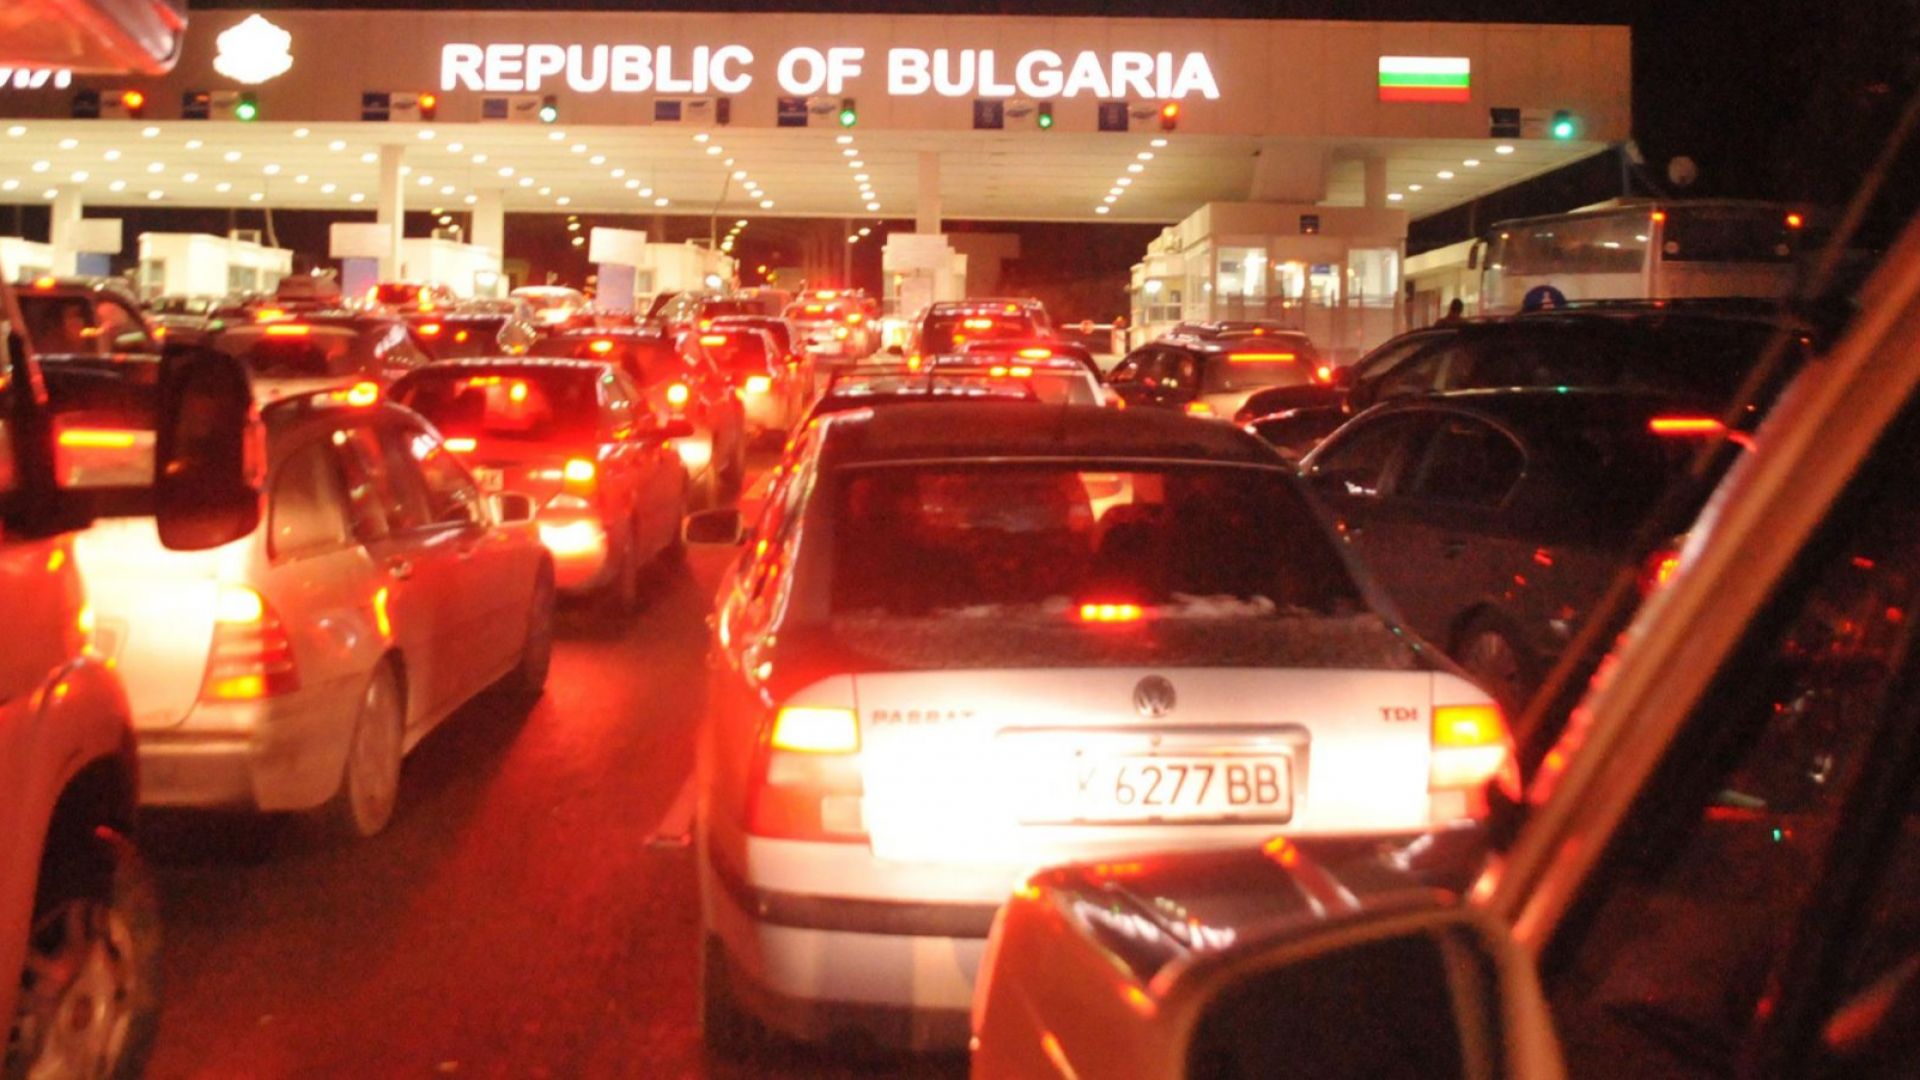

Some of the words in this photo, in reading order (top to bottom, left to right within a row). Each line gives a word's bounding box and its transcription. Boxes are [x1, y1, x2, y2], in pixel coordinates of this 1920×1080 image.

[440, 43, 754, 93] REPUBLIC
[777, 47, 865, 95] OF
[888, 48, 1221, 99] BULGARIA
[1379, 706, 1418, 722] TDI
[1114, 763, 1216, 806] 6277
[1225, 763, 1281, 806] BB
